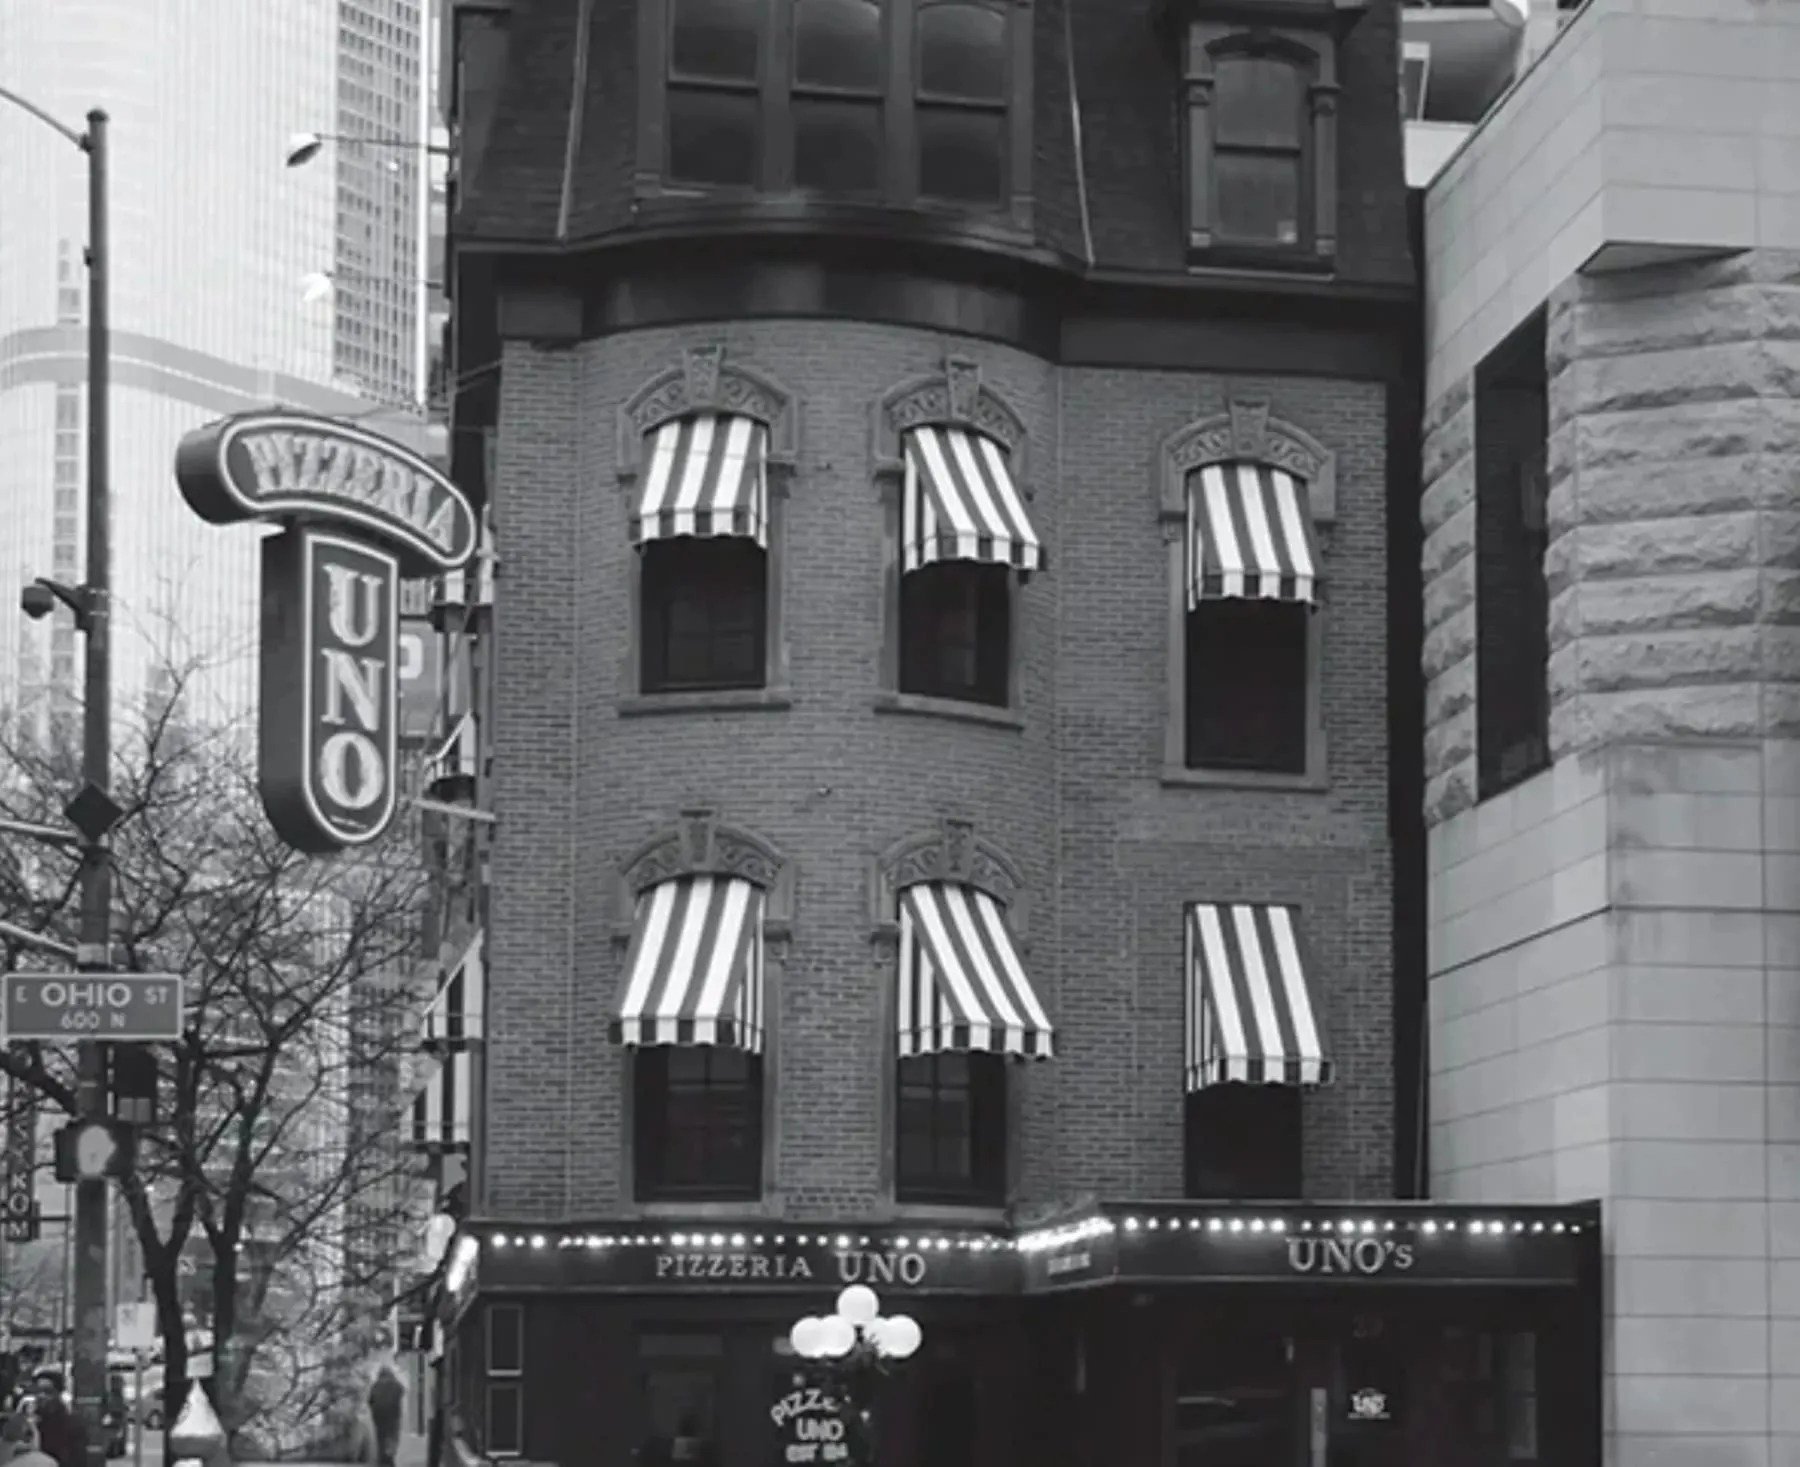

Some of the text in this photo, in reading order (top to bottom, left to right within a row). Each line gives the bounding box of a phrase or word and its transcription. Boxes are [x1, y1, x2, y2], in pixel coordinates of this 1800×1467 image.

[241, 431, 456, 554] PIZZERIA
[320, 562, 385, 810] UNO
[15, 982, 169, 1008] E OHIO ST
[60, 1010, 126, 1030] 600 N
[655, 1251, 926, 1285] PIZZERIA UNO
[1285, 1237, 1414, 1273] UNO's
[795, 1417, 846, 1442] UNO
